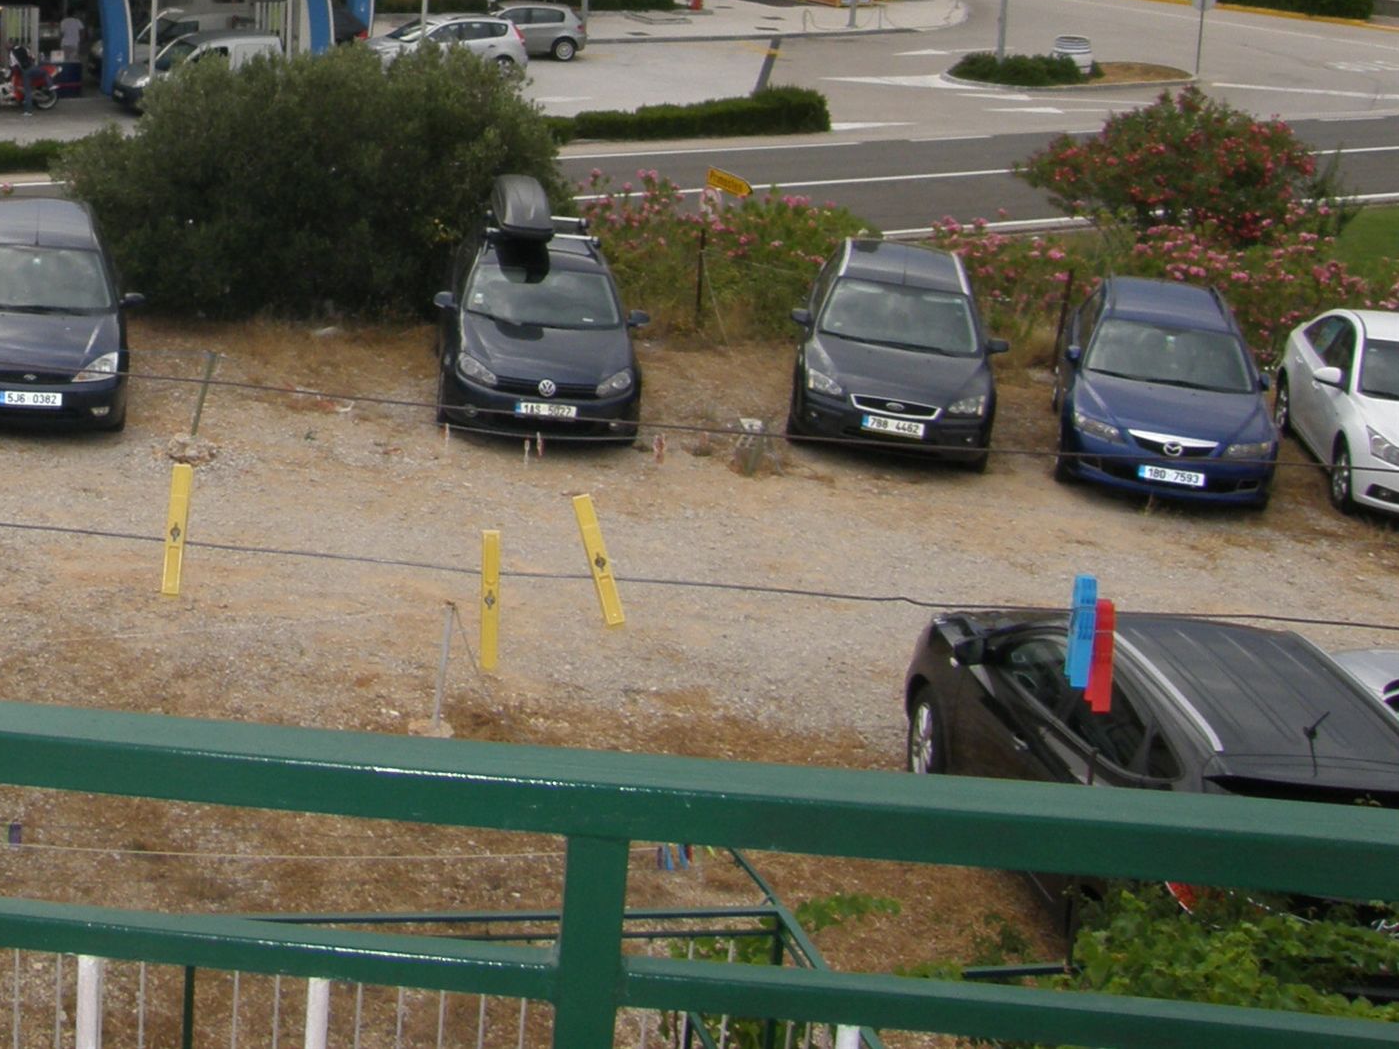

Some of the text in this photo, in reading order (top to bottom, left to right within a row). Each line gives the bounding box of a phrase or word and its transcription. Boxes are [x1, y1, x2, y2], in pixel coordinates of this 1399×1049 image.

[7, 392, 57, 405] 5J6 0382
[1173, 470, 1200, 484] 7593
